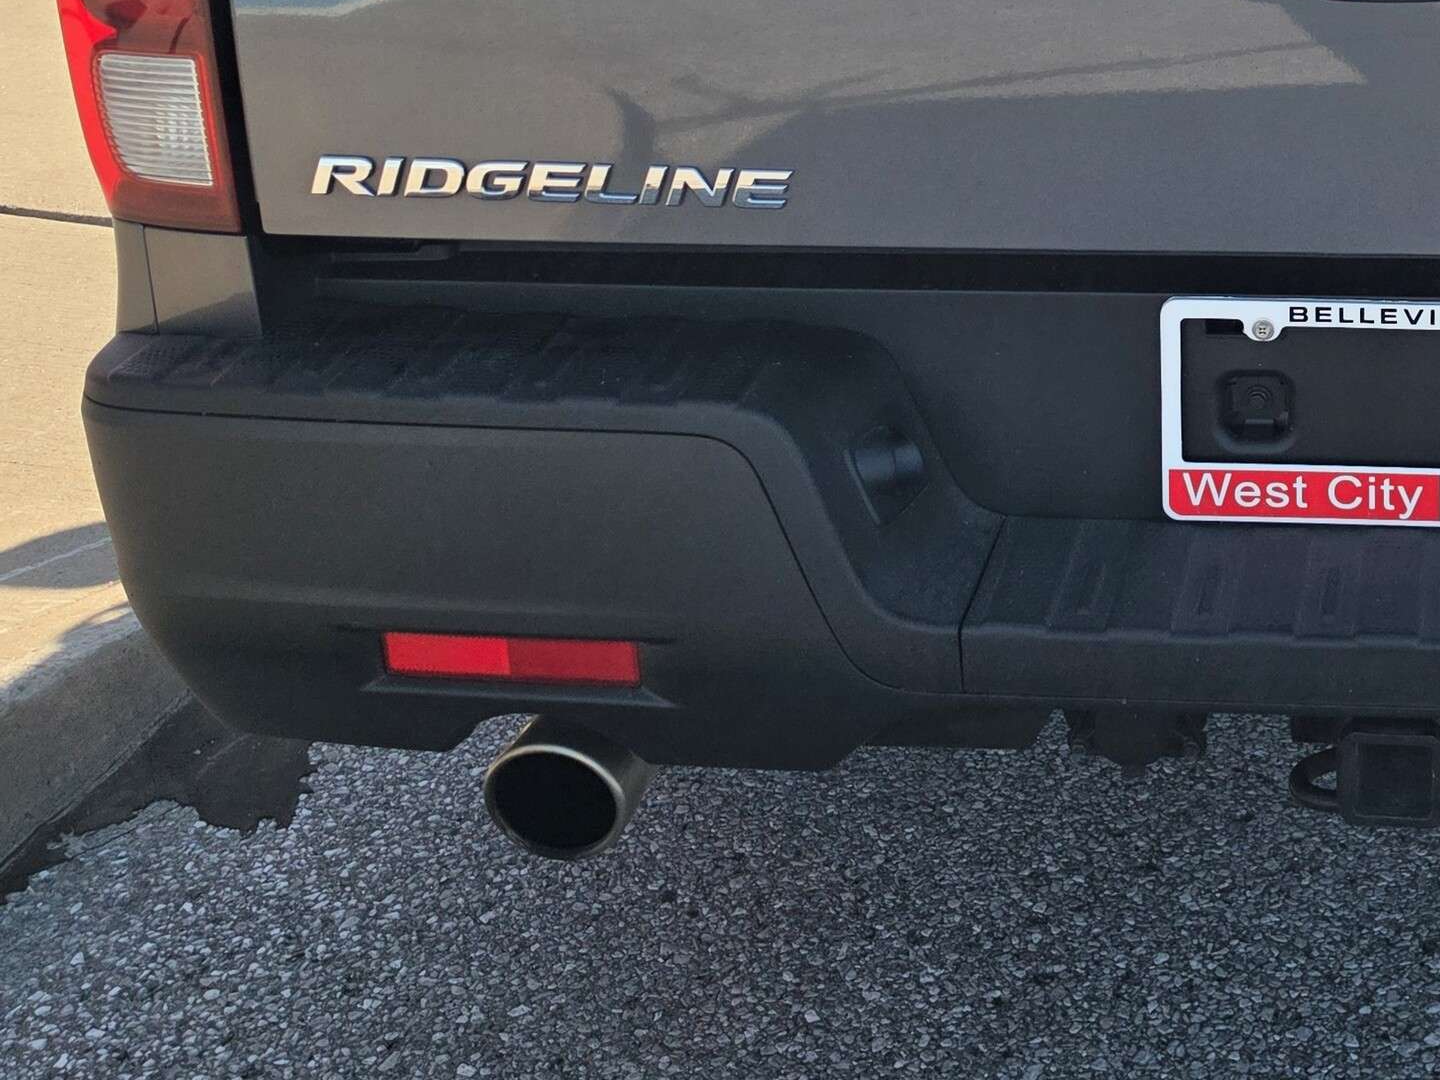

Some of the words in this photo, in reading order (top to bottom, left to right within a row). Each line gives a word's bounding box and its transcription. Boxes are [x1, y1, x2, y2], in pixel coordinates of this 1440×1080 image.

[311, 154, 795, 210] RIDGELINE
[1182, 472, 1307, 509] West
[1327, 475, 1423, 519] City
